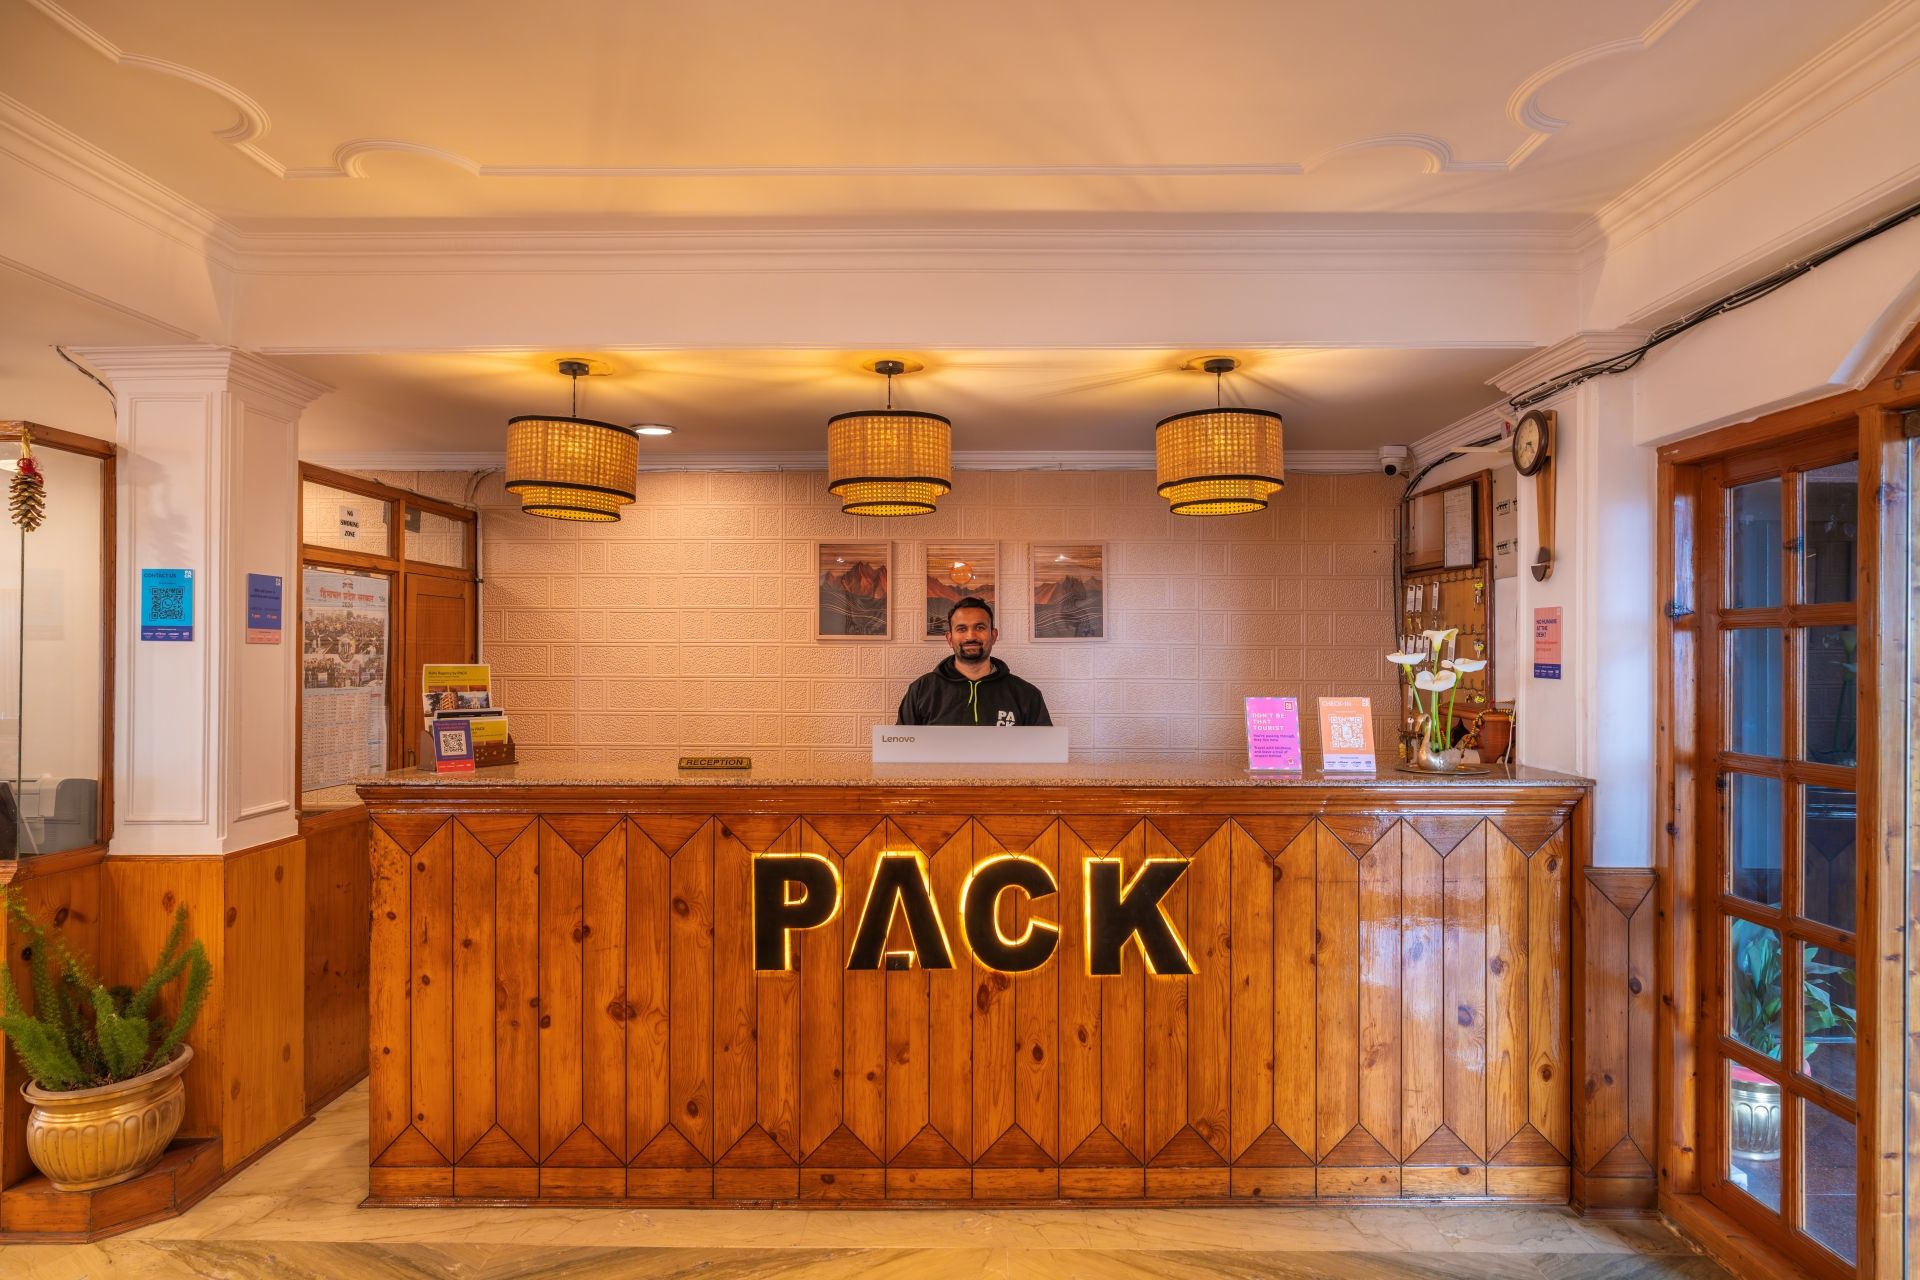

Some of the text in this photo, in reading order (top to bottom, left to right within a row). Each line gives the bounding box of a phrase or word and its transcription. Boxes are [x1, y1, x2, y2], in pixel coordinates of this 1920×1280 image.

[344, 530, 356, 538] ZONE
[997, 710, 1016, 721] PA
[882, 735, 916, 743] Lenovo
[753, 853, 1198, 976] PACK
